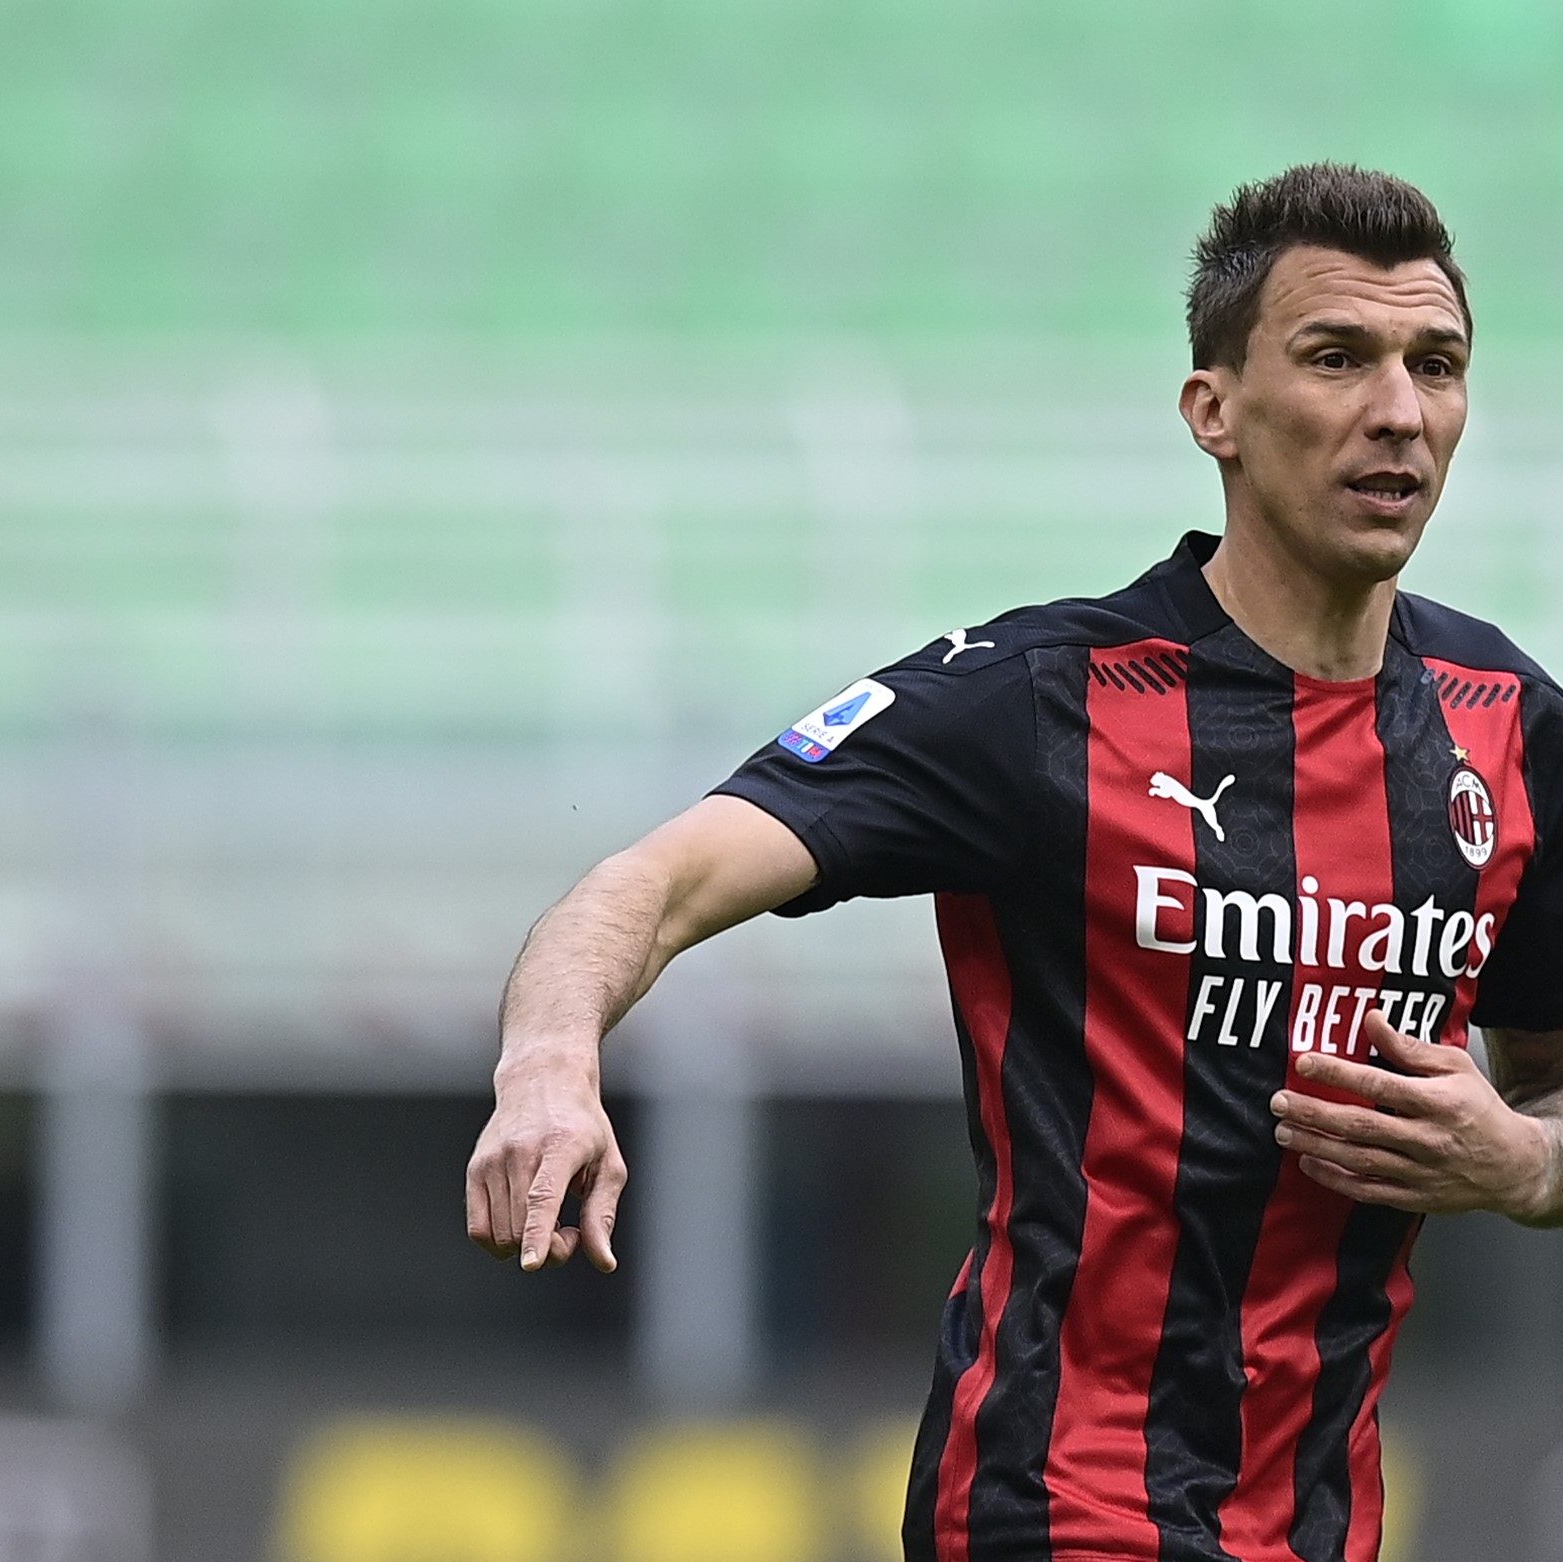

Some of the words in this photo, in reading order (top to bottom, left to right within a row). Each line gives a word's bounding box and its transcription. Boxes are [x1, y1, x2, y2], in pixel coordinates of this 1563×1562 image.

[1455, 773, 1482, 794] ACM
[1465, 845, 1488, 859] 1899
[1133, 865, 1495, 979] Emirates
[1187, 974, 1283, 1049] FLY
[1292, 983, 1447, 1057] BETTER
